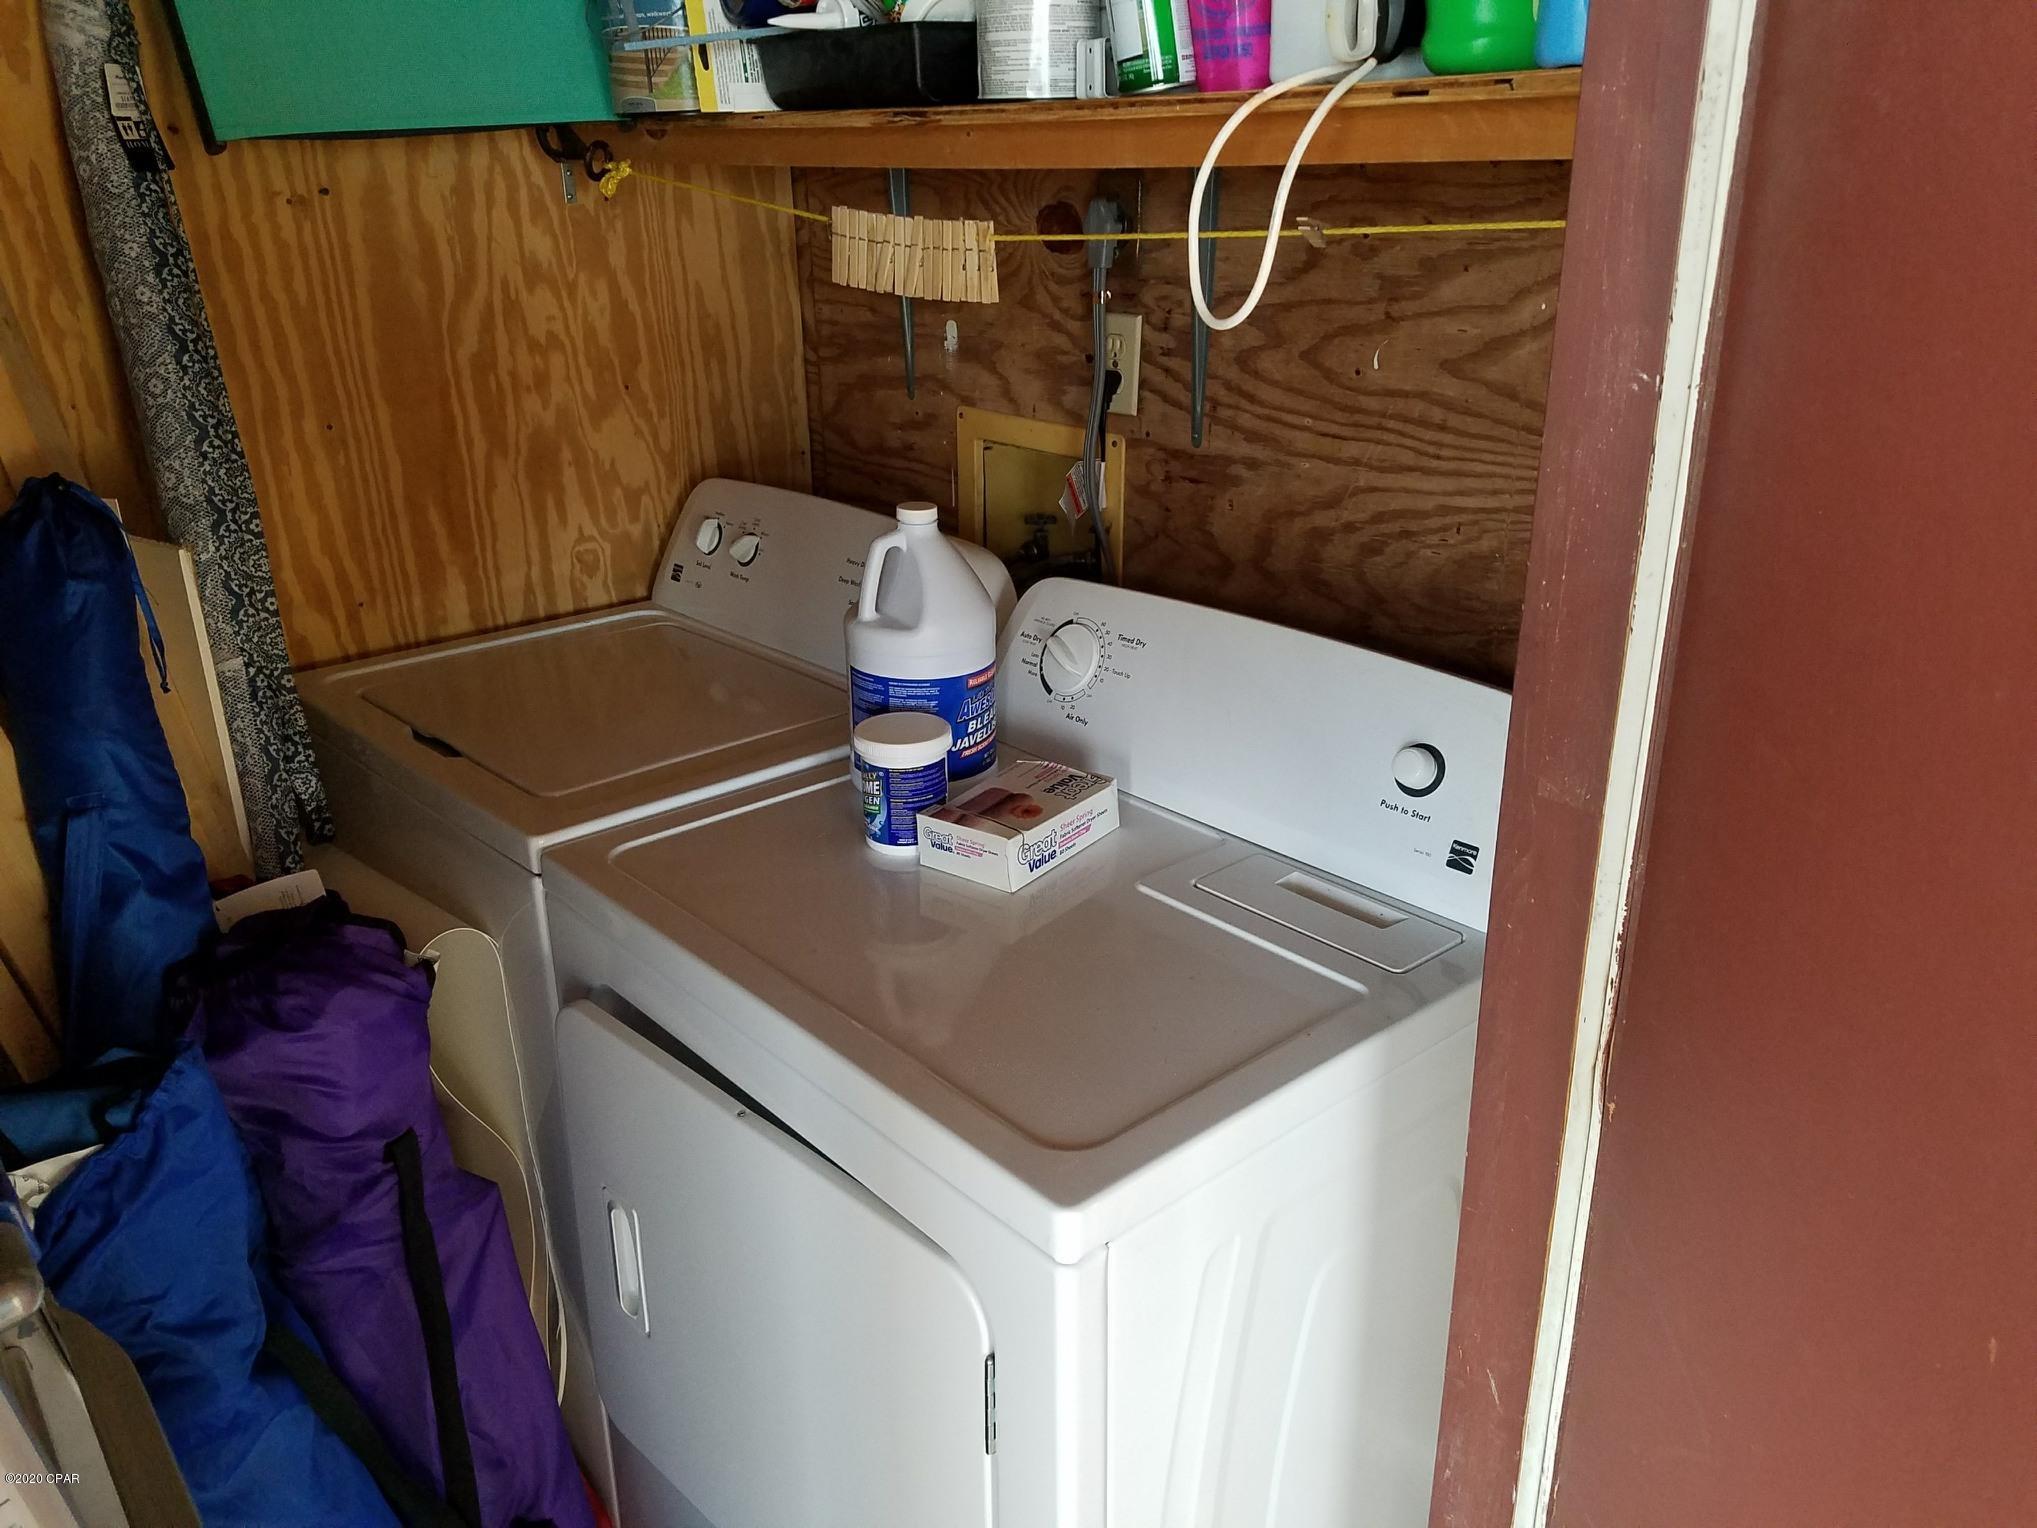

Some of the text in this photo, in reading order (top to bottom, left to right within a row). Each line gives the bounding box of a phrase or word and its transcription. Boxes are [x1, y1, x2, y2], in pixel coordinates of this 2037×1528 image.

[1020, 631, 1033, 640] Auto
[1032, 633, 1043, 644] Dry
[1117, 633, 1136, 645] Timed
[1135, 638, 1147, 649] Dry
[1021, 657, 1039, 668] Normal
[957, 691, 995, 722] AWES
[967, 706, 997, 735] BLEA
[1065, 712, 1089, 727] Air Only
[863, 780, 880, 796] ME
[1060, 808, 1094, 831] Sheer Spring
[1380, 799, 1431, 822] Push to Start
[923, 826, 953, 846] Great
[929, 839, 954, 854] Value
[1017, 828, 1059, 866] Great
[1453, 843, 1477, 856] Kenmore
[1027, 848, 1058, 873] Value
